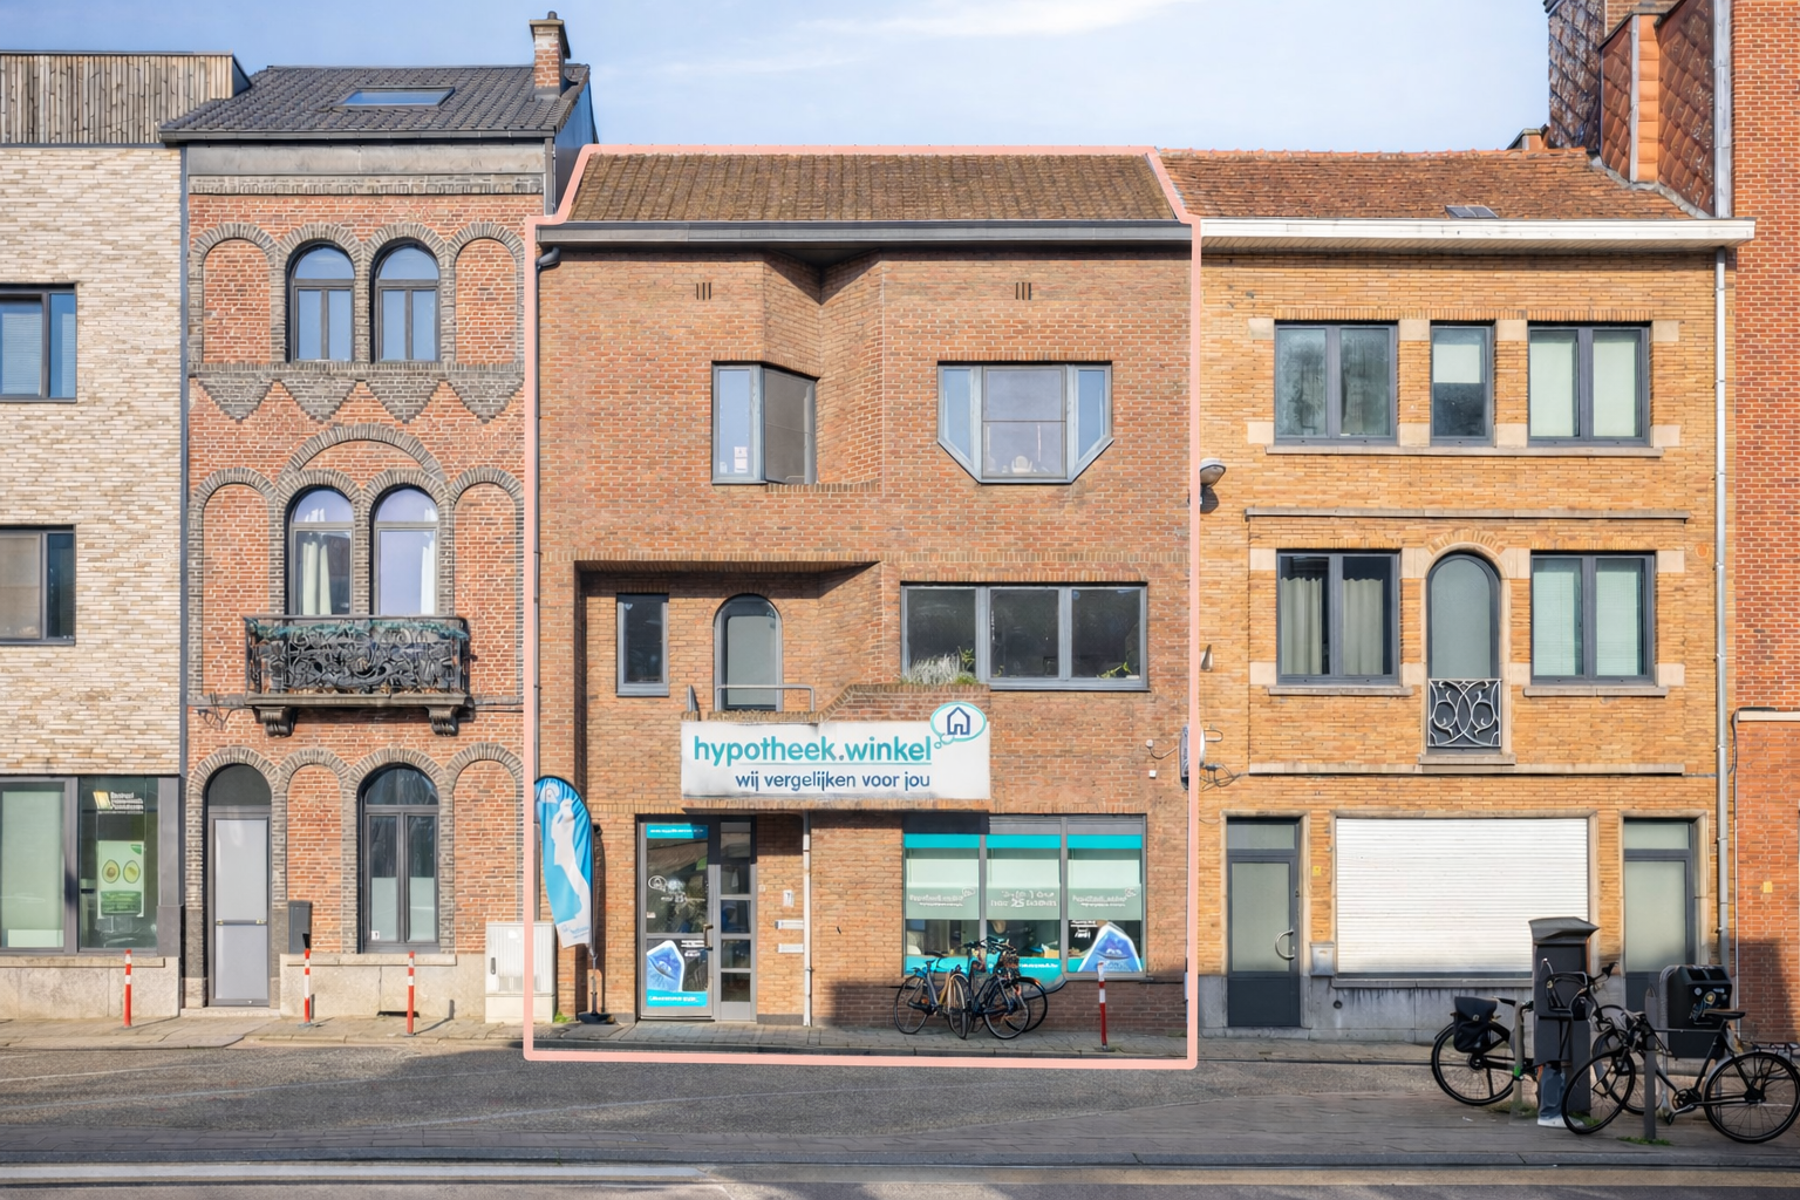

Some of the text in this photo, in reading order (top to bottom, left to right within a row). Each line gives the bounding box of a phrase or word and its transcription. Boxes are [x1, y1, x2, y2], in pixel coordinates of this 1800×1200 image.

[694, 735, 932, 766] hypotheek.winkel
[735, 771, 931, 792] wij vergelijken voor jou
